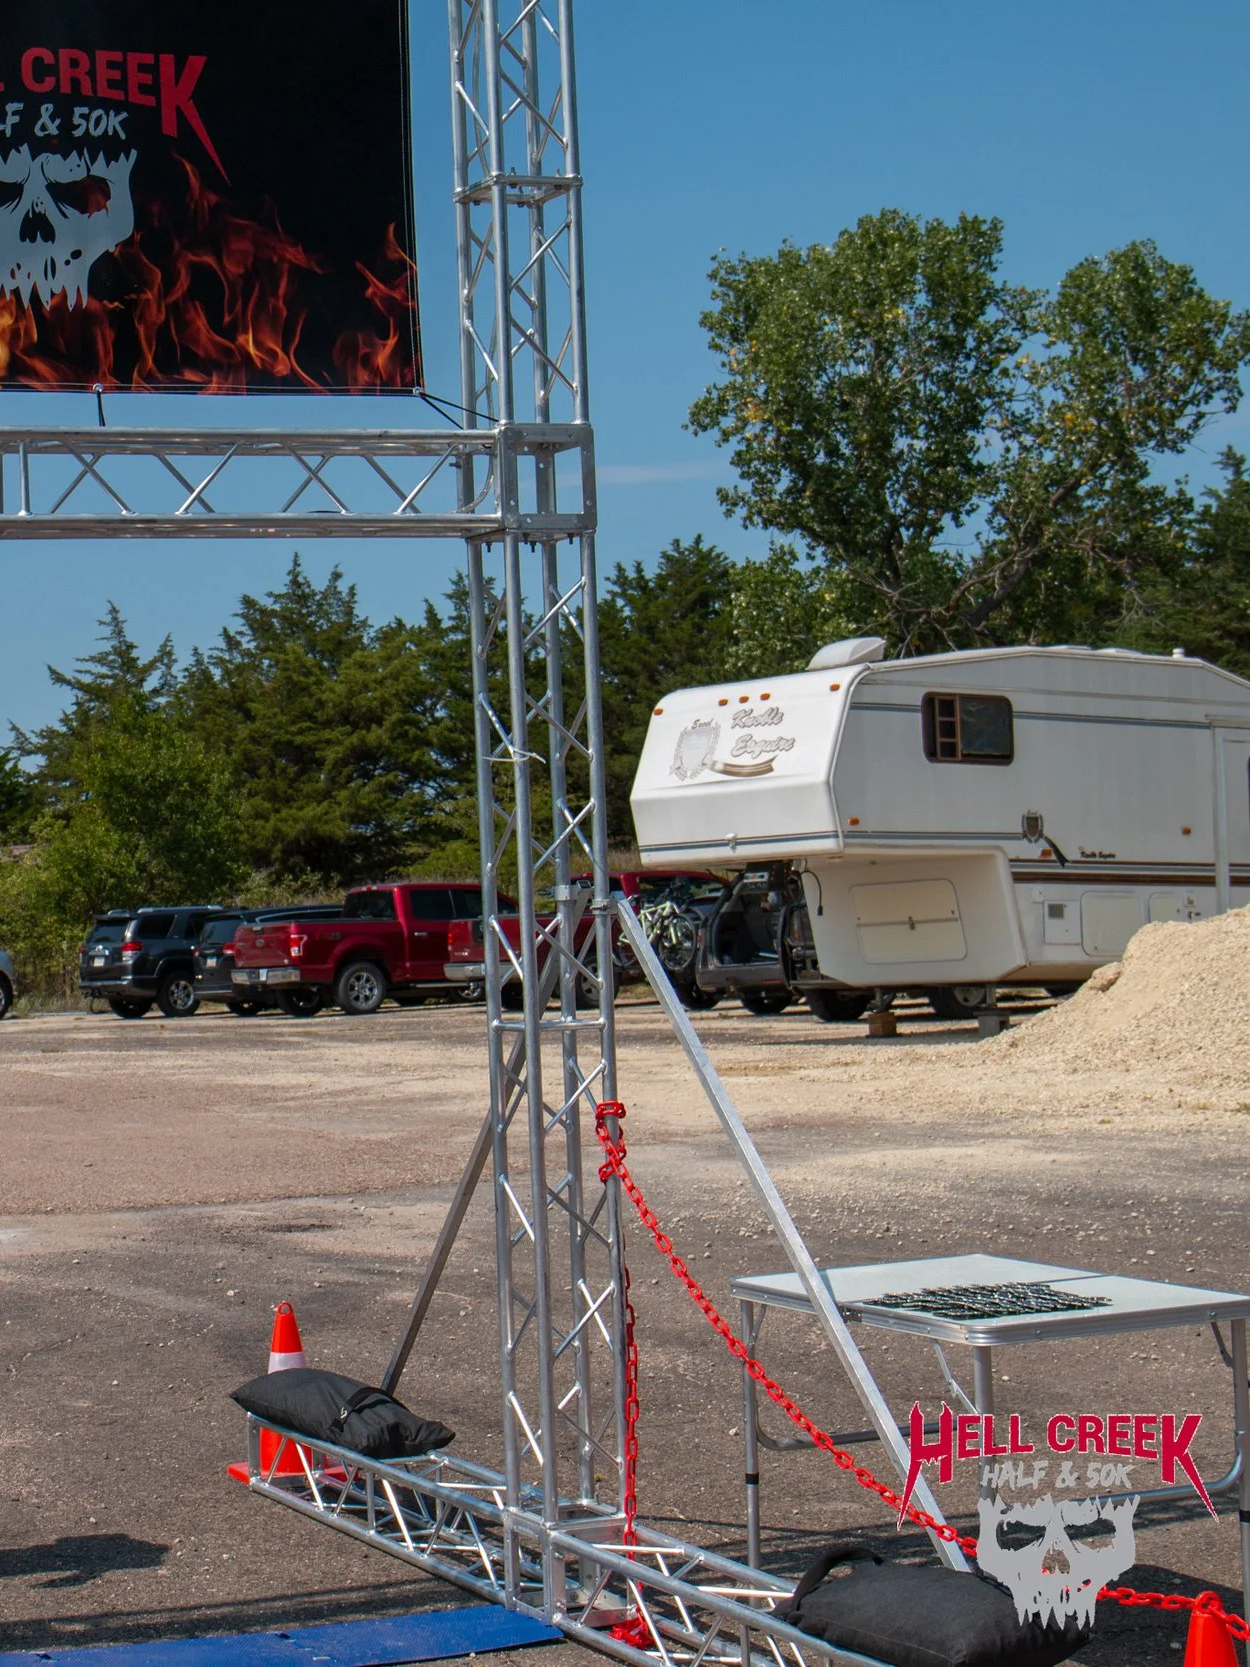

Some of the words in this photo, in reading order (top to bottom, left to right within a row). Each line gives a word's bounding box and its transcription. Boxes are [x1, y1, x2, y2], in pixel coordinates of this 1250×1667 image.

[21, 47, 231, 187] CREEK
[34, 103, 62, 137] &
[71, 106, 129, 140] 50K
[730, 733, 796, 759] Esquire
